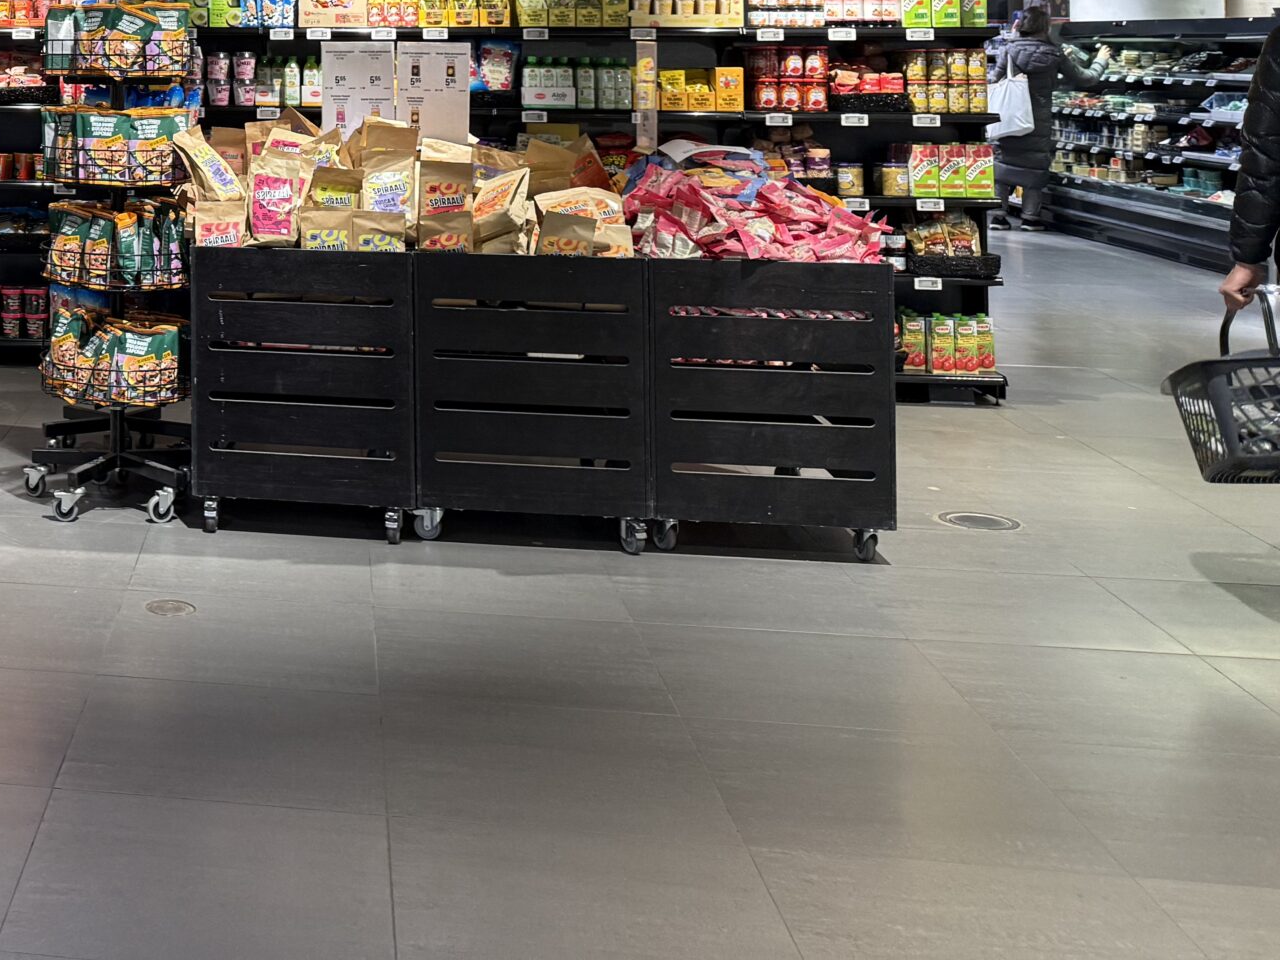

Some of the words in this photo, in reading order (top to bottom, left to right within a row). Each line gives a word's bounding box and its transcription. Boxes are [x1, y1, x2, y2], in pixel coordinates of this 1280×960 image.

[913, 158, 939, 179] TYMBARK
[967, 158, 993, 179] TYMBARK
[372, 183, 406, 195] SPIRAALI
[321, 196, 350, 205] SPIRAALI
[429, 195, 465, 208] SPIRAALI
[203, 234, 237, 246] SPIRAALI
